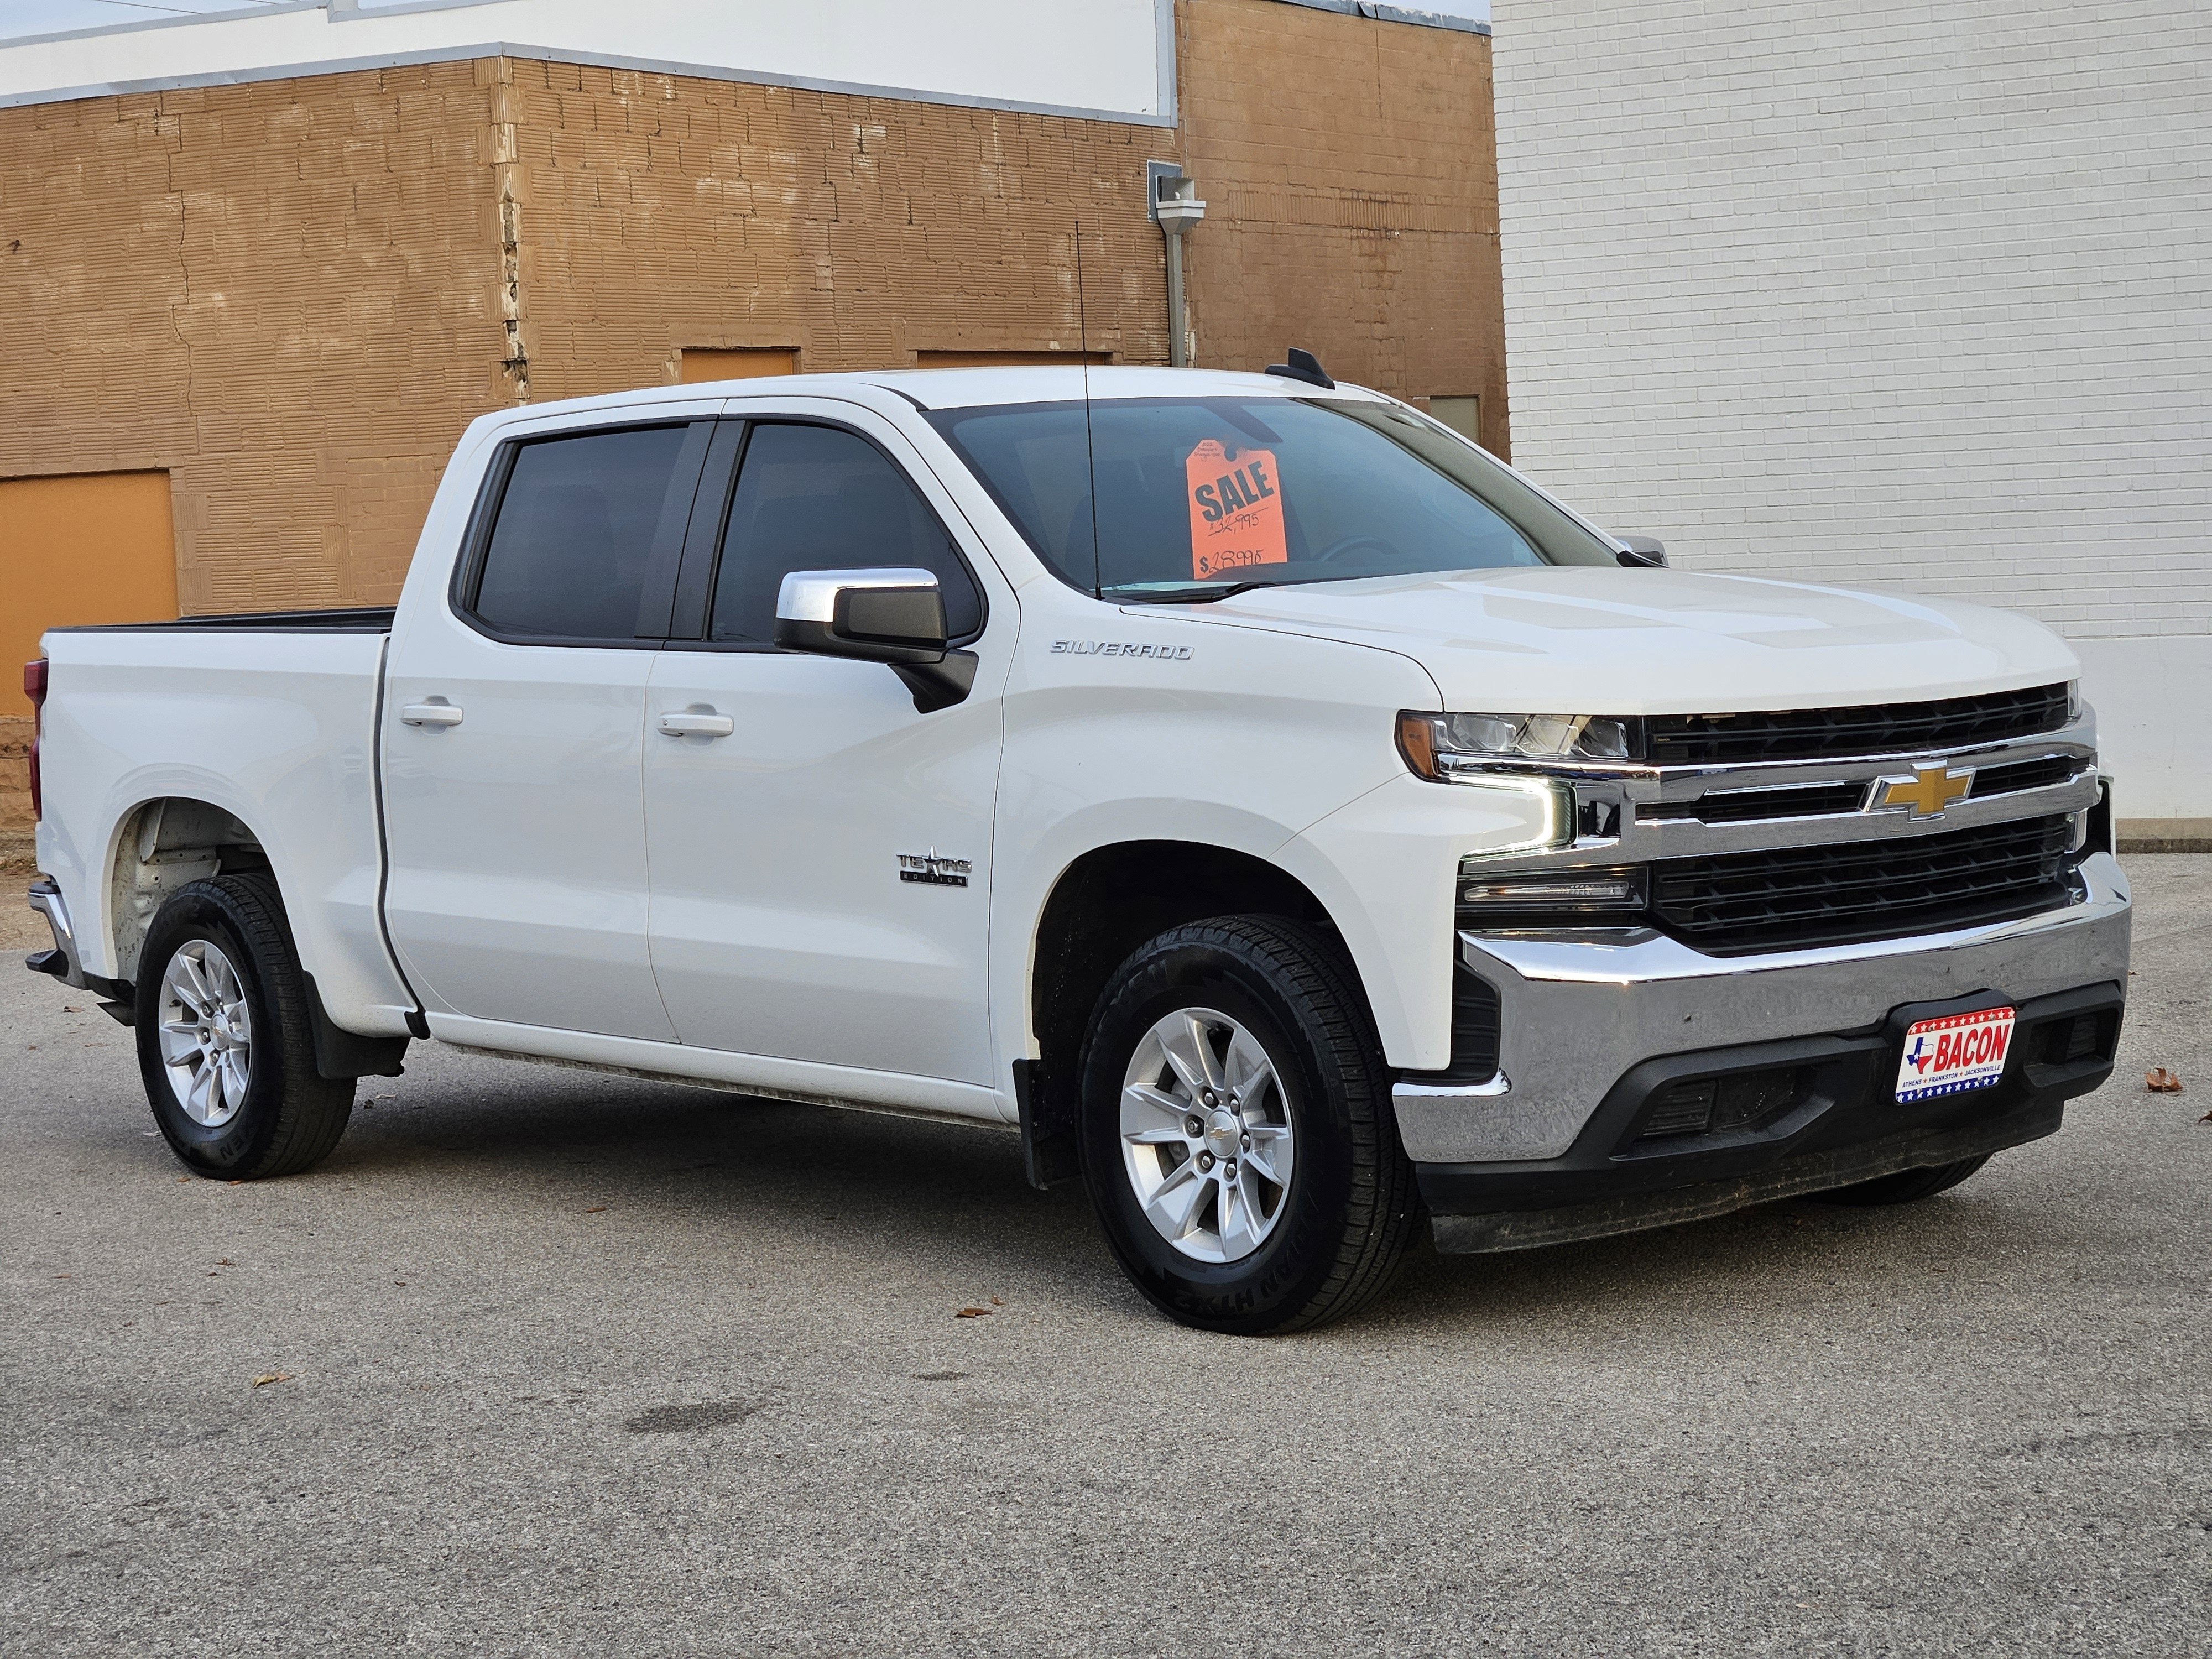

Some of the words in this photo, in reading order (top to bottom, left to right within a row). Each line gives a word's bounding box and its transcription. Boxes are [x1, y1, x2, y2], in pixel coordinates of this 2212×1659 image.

[1195, 460, 1275, 522] SALE
[1050, 640, 1195, 660] SILVERADO
[904, 873, 962, 884] EDITION
[1933, 1024, 2010, 1072] BACON
[1902, 1079, 1922, 1088] ATHENS
[1928, 1073, 1958, 1083] FRANKSTON
[1964, 1065, 2001, 1076] JACKSONVILLE
